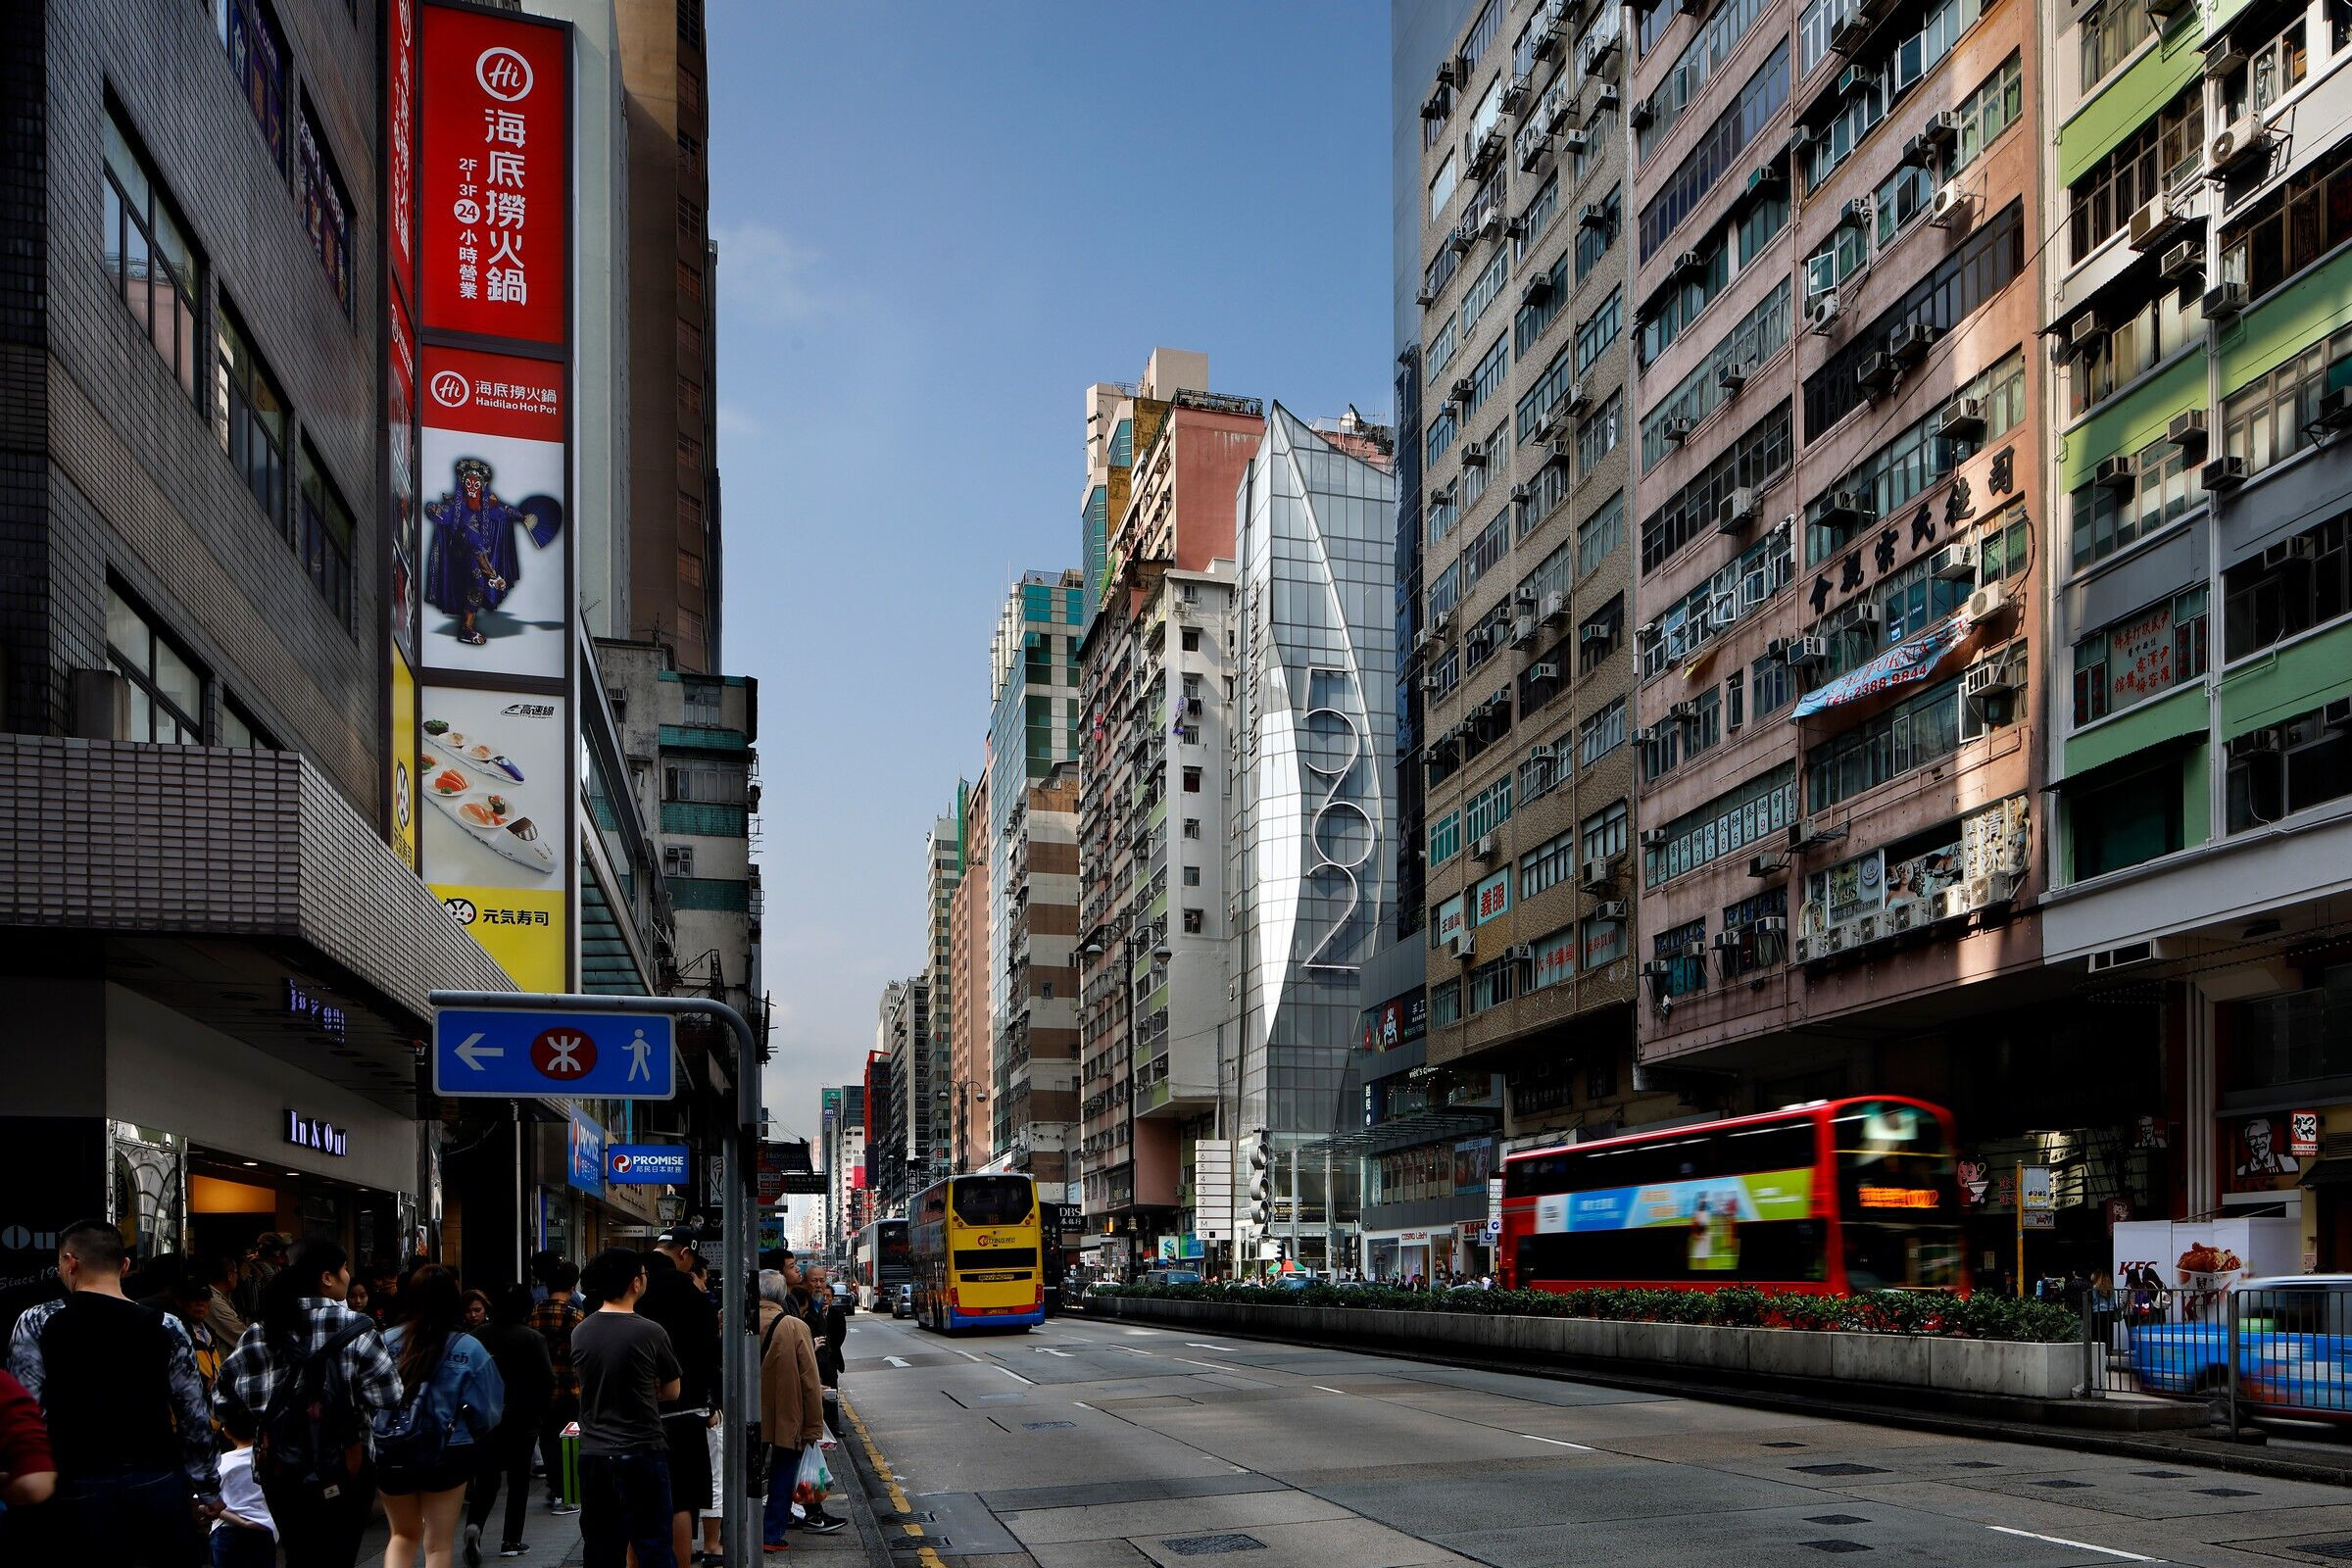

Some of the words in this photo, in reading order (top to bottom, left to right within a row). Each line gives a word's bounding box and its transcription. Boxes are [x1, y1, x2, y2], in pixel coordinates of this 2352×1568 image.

[484, 109, 527, 306] 海底撈火鍋
[459, 229, 478, 299] 小時營業
[474, 379, 558, 405] 海底撈火鍋
[475, 397, 518, 413] Haidilao
[519, 401, 538, 414] Hot
[539, 404, 558, 416] Pot
[1890, 662, 1929, 685] 9844
[482, 908, 550, 926] 元気寿司
[290, 1110, 307, 1145] In
[311, 1122, 321, 1149] &
[324, 1124, 347, 1156] Out
[1200, 1141, 1206, 1150] 7
[633, 1155, 684, 1165] PROMISE
[1200, 1163, 1206, 1172] 5
[1200, 1175, 1206, 1184] 4
[1059, 1206, 1081, 1216] DBS
[1200, 1208, 1206, 1217] 1
[1, 1225, 58, 1250] Ou
